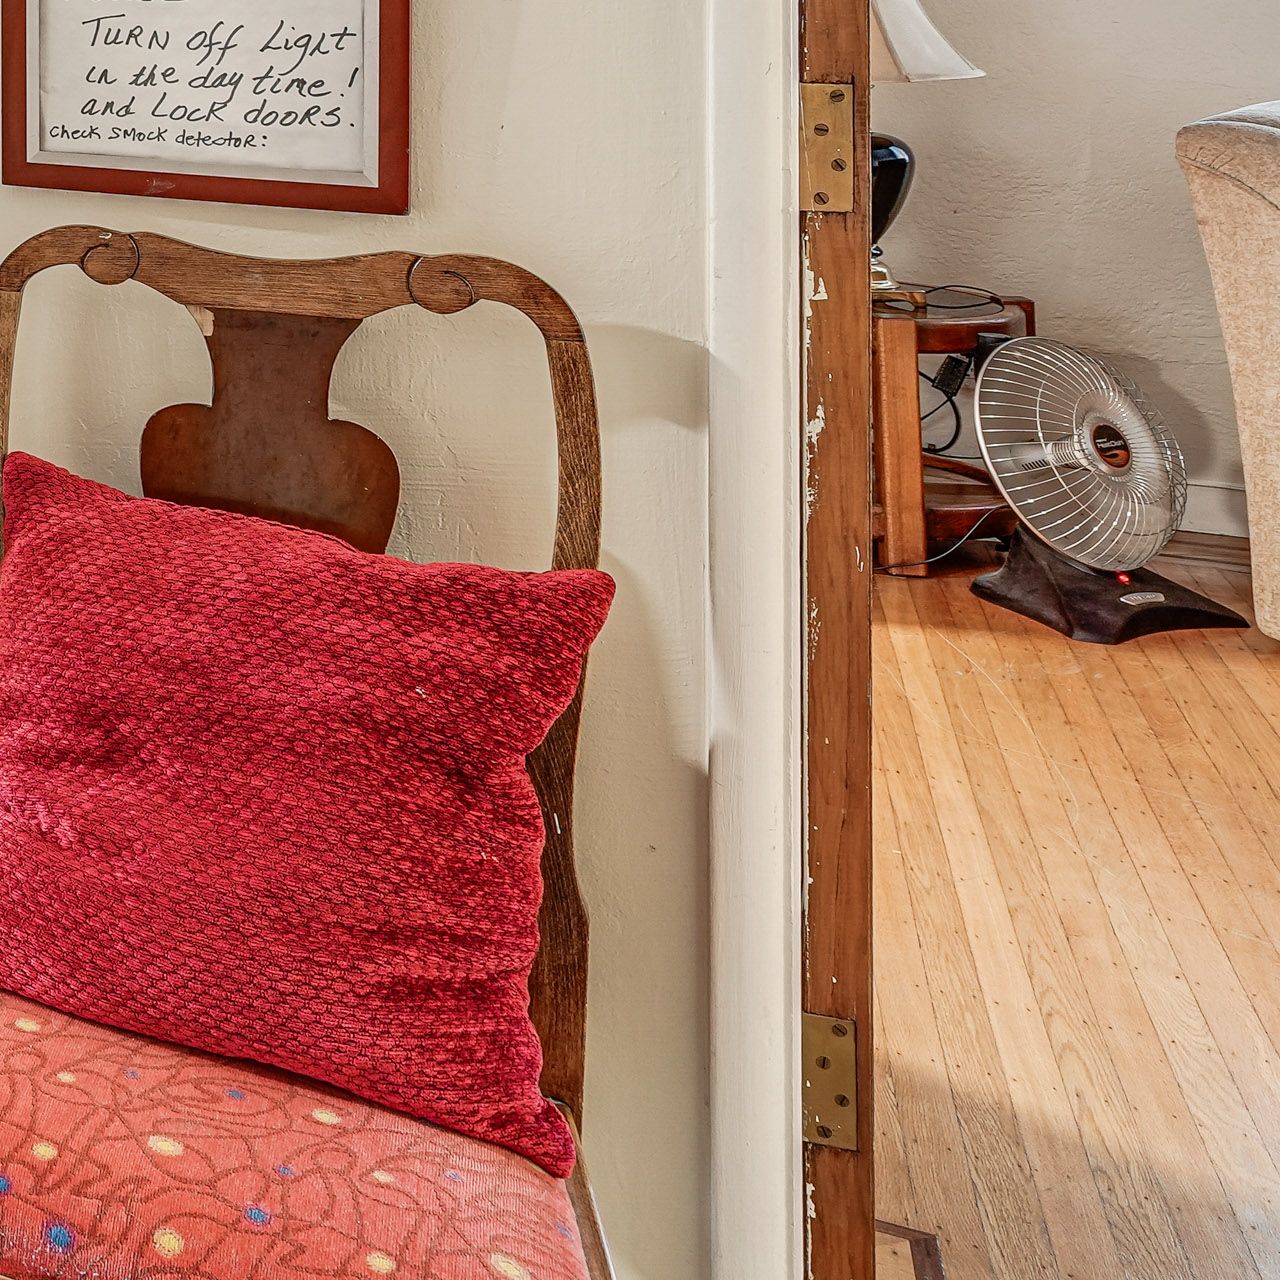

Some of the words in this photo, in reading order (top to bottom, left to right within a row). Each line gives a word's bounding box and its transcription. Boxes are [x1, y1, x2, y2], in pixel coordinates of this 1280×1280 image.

[85, 65, 118, 85] in
[128, 64, 180, 87] the
[80, 95, 136, 118] and
